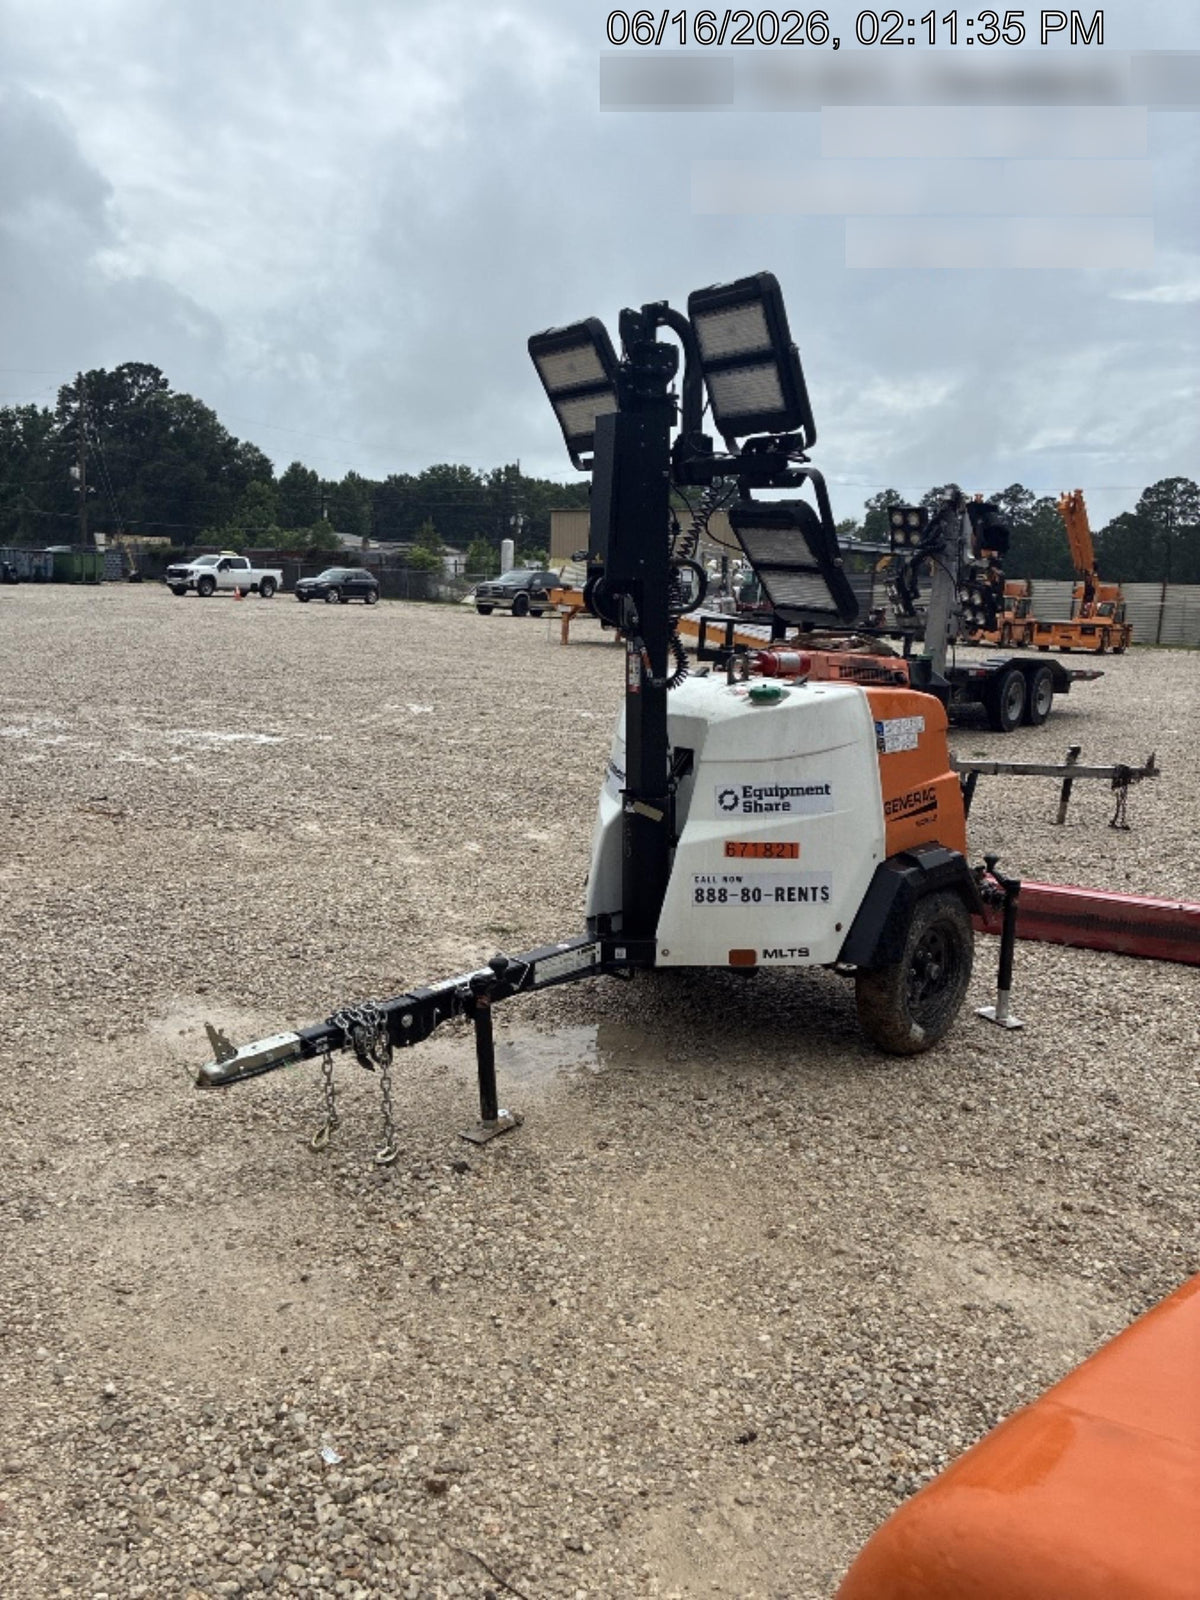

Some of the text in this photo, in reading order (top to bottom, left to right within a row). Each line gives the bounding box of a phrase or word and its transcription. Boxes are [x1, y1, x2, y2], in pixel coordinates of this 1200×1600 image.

[742, 783, 831, 800] Equipment
[742, 801, 791, 813] Share
[884, 787, 937, 816] GENERAC
[726, 842, 796, 858] 671821
[694, 875, 744, 884] CALL NOW
[694, 885, 830, 903] 888-80-RENTS
[763, 948, 810, 959] MLTS
